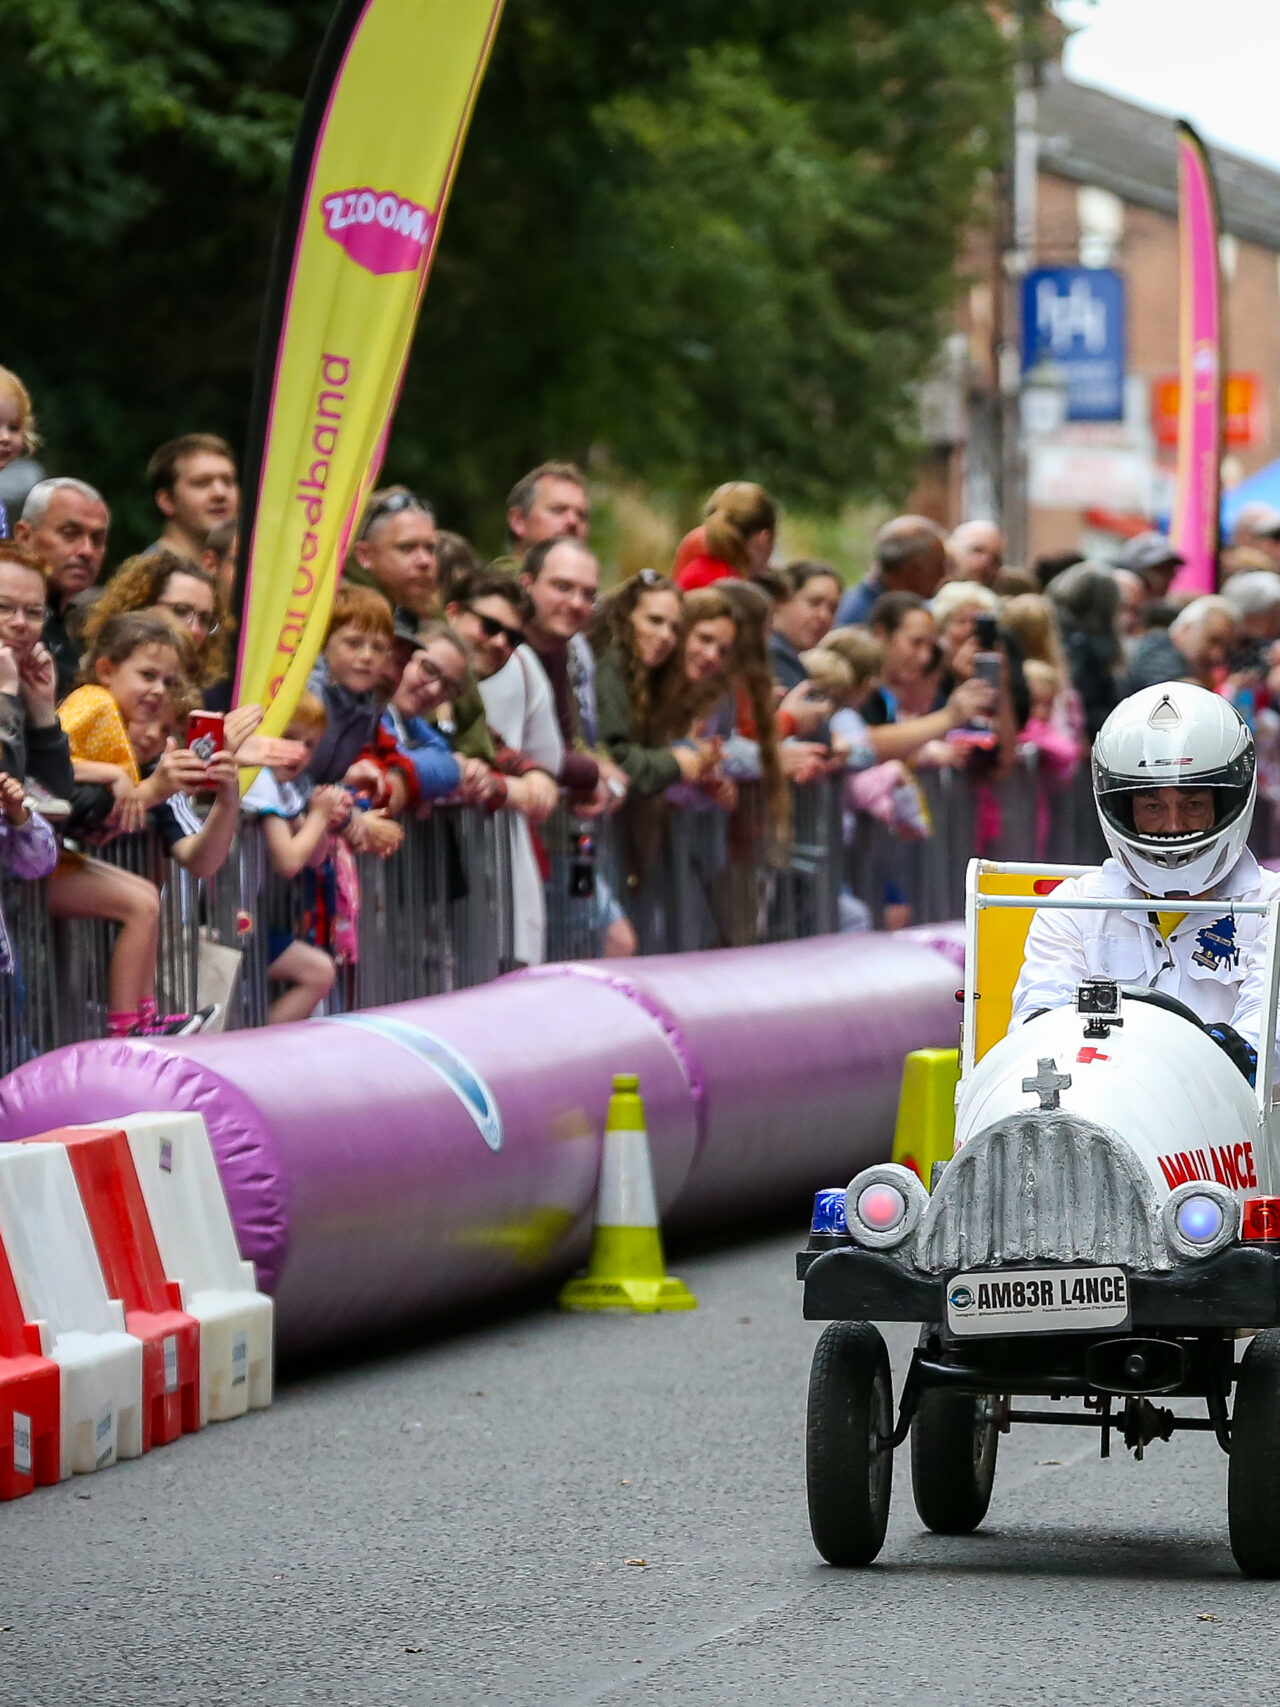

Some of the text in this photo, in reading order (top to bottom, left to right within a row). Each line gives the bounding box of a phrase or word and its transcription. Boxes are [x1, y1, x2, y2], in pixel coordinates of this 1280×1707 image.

[1138, 757, 1194, 768] LS2
[978, 1276, 1126, 1310] AM83R L4NCE
